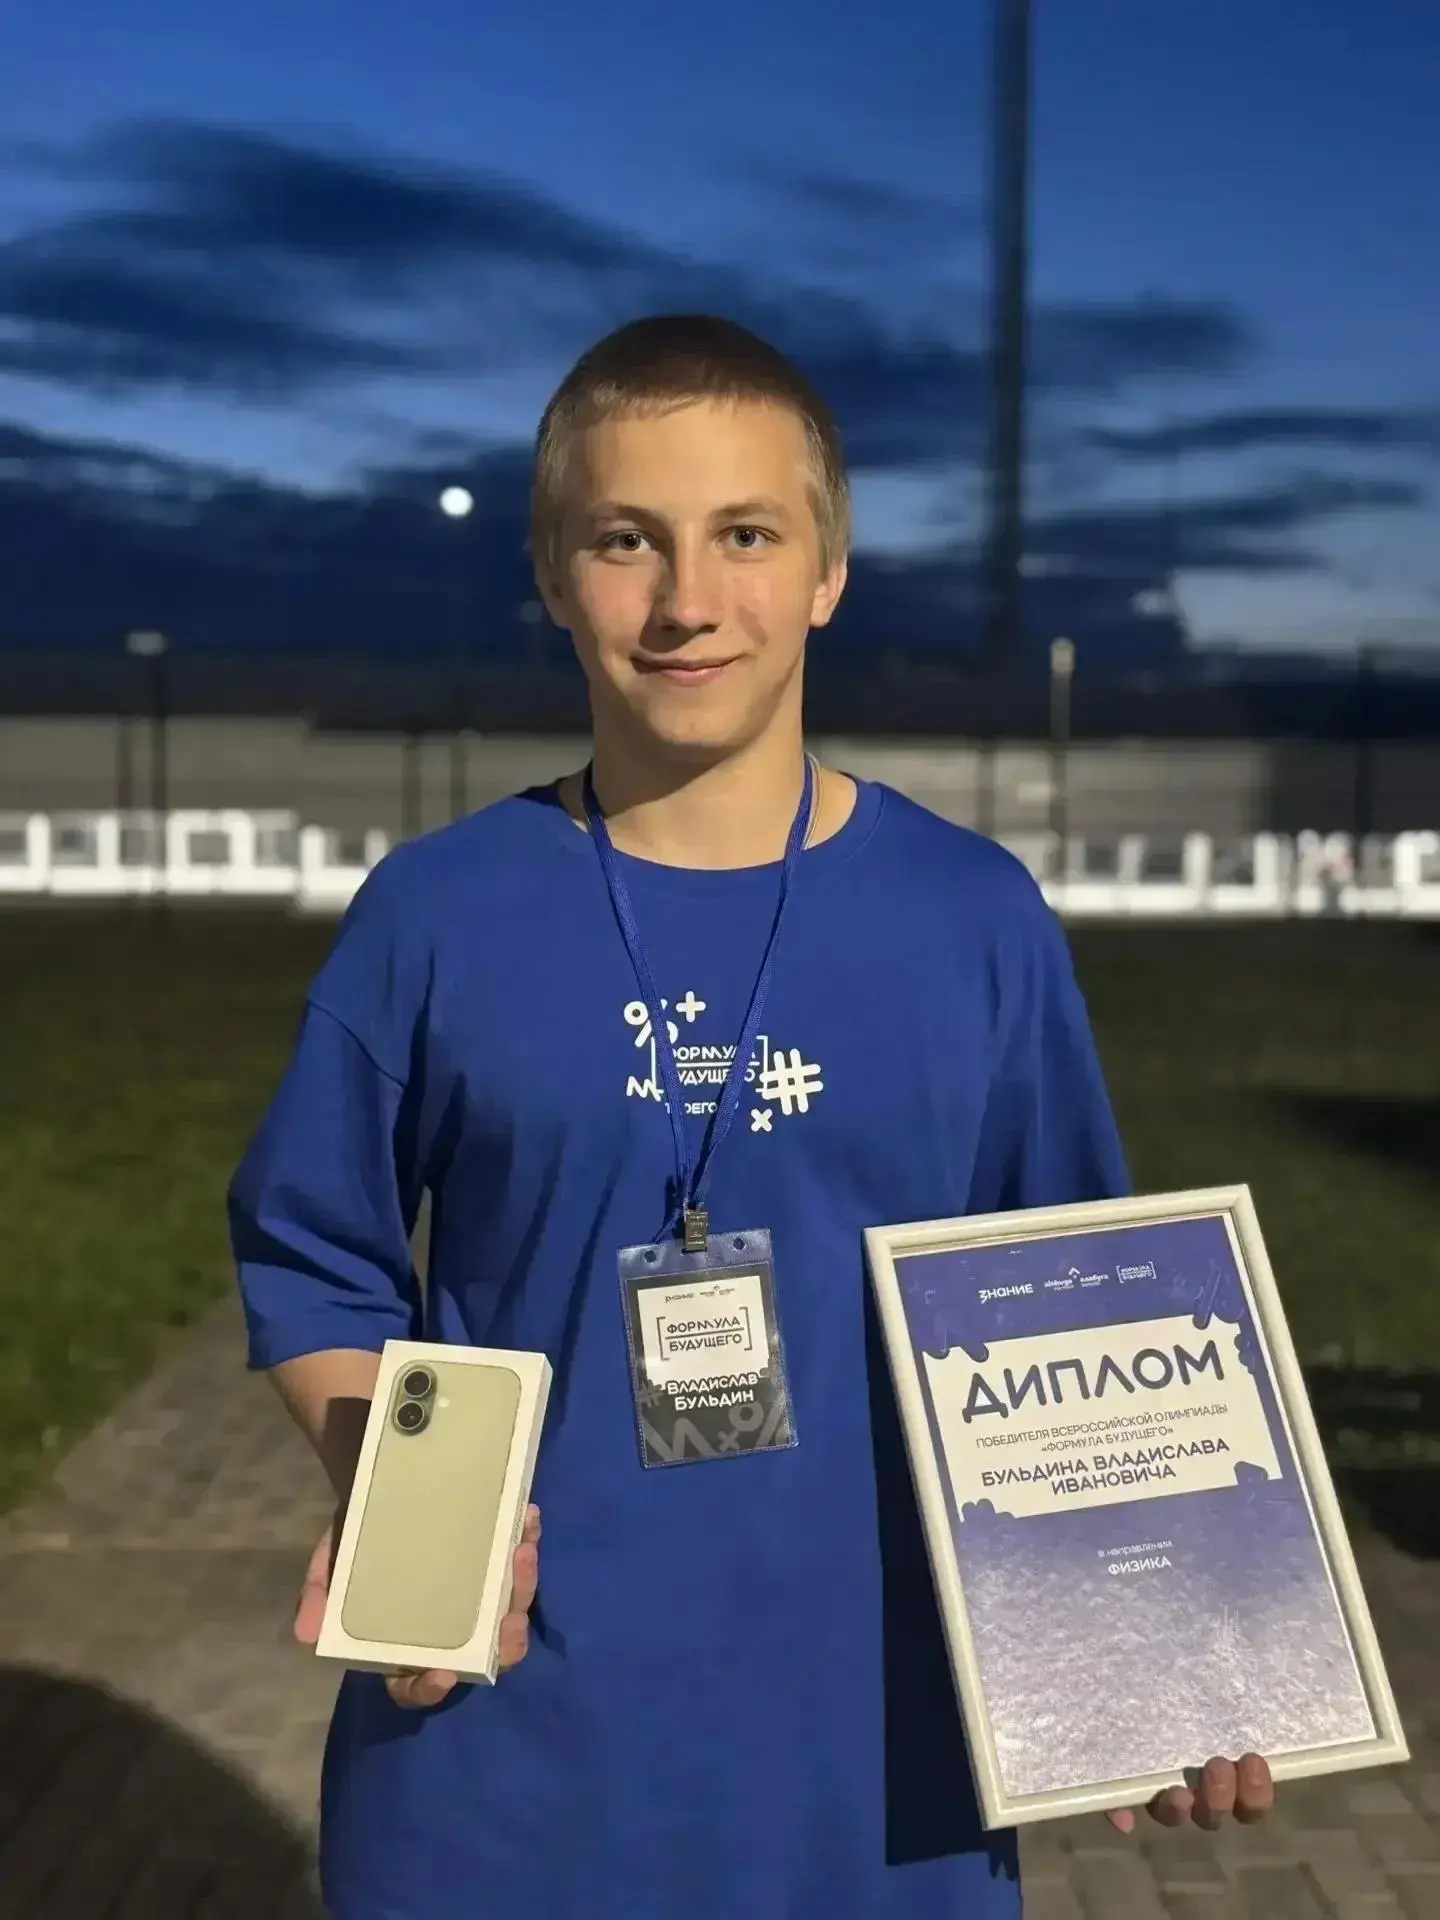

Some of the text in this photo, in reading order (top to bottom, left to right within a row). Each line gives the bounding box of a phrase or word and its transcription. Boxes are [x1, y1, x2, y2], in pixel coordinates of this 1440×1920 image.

[672, 1045, 756, 1061] ОРМУ
[677, 1068, 756, 1086] УДУЩЕО
[666, 1316, 741, 1334] ФОРМУЛА
[669, 1333, 742, 1352] БУДУЩЕГО
[667, 1373, 758, 1395] ВЛАДИСЛАВ
[961, 1339, 1225, 1424] ДИПЛОМ
[674, 1389, 754, 1411] БУЛЬДИН
[976, 1403, 1228, 1448] ПОБЕДИТЕЛЯ ВСЕРОССИЙСКОЙ ОЛИМПИАДЫ
[981, 1438, 1230, 1487] БУЛЬДИНА ВЛАДИСЛАВА
[1051, 1463, 1177, 1495] ИВАНОВИЧА
[1108, 1555, 1172, 1576] ФИЗИКА
